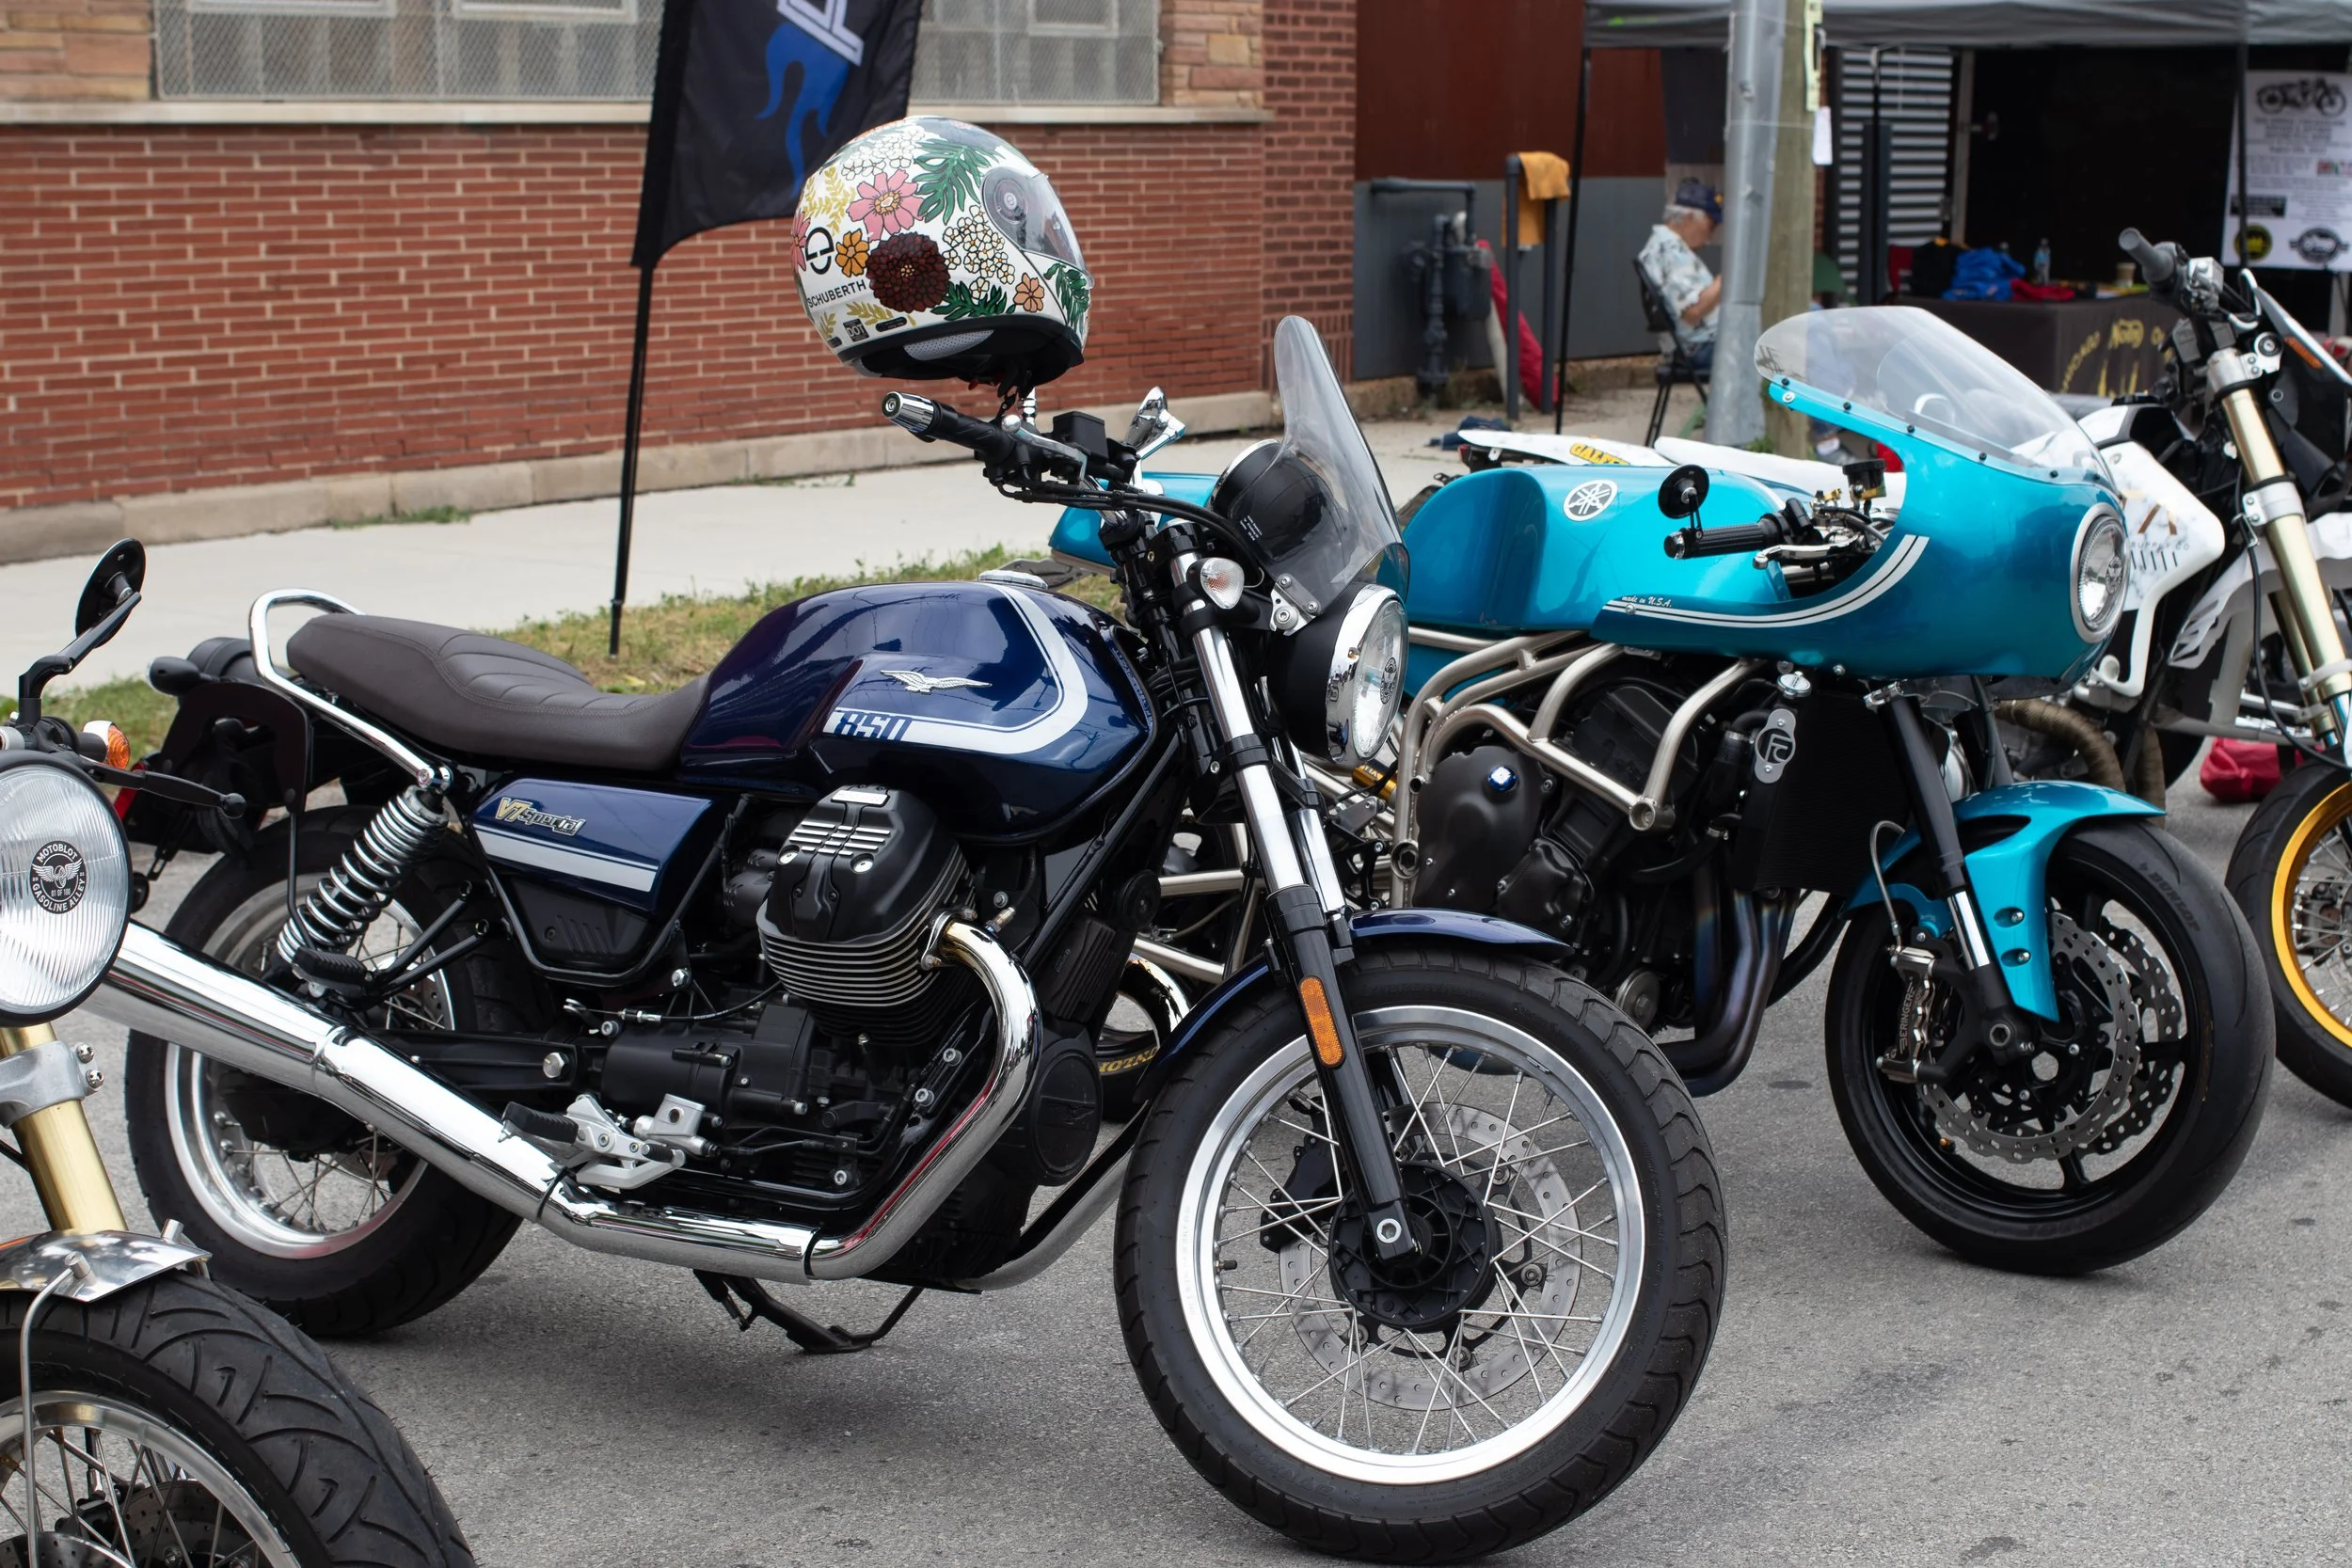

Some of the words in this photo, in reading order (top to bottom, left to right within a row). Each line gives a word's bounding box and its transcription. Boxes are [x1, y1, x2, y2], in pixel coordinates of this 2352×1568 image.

[807, 279, 866, 309] SCHUBERTH
[847, 324, 865, 338] DOT
[1621, 594, 1639, 603] made
[1639, 595, 1646, 604] in
[1647, 595, 1673, 608] U.S.A.
[834, 710, 912, 741] 850
[496, 797, 533, 822] V7
[518, 808, 586, 832] Special
[37, 844, 78, 863] MOTOBLOT
[32, 884, 68, 912] GASOLINE
[69, 879, 86, 908] ALLEY
[1899, 981, 1915, 1054] BERINGER
